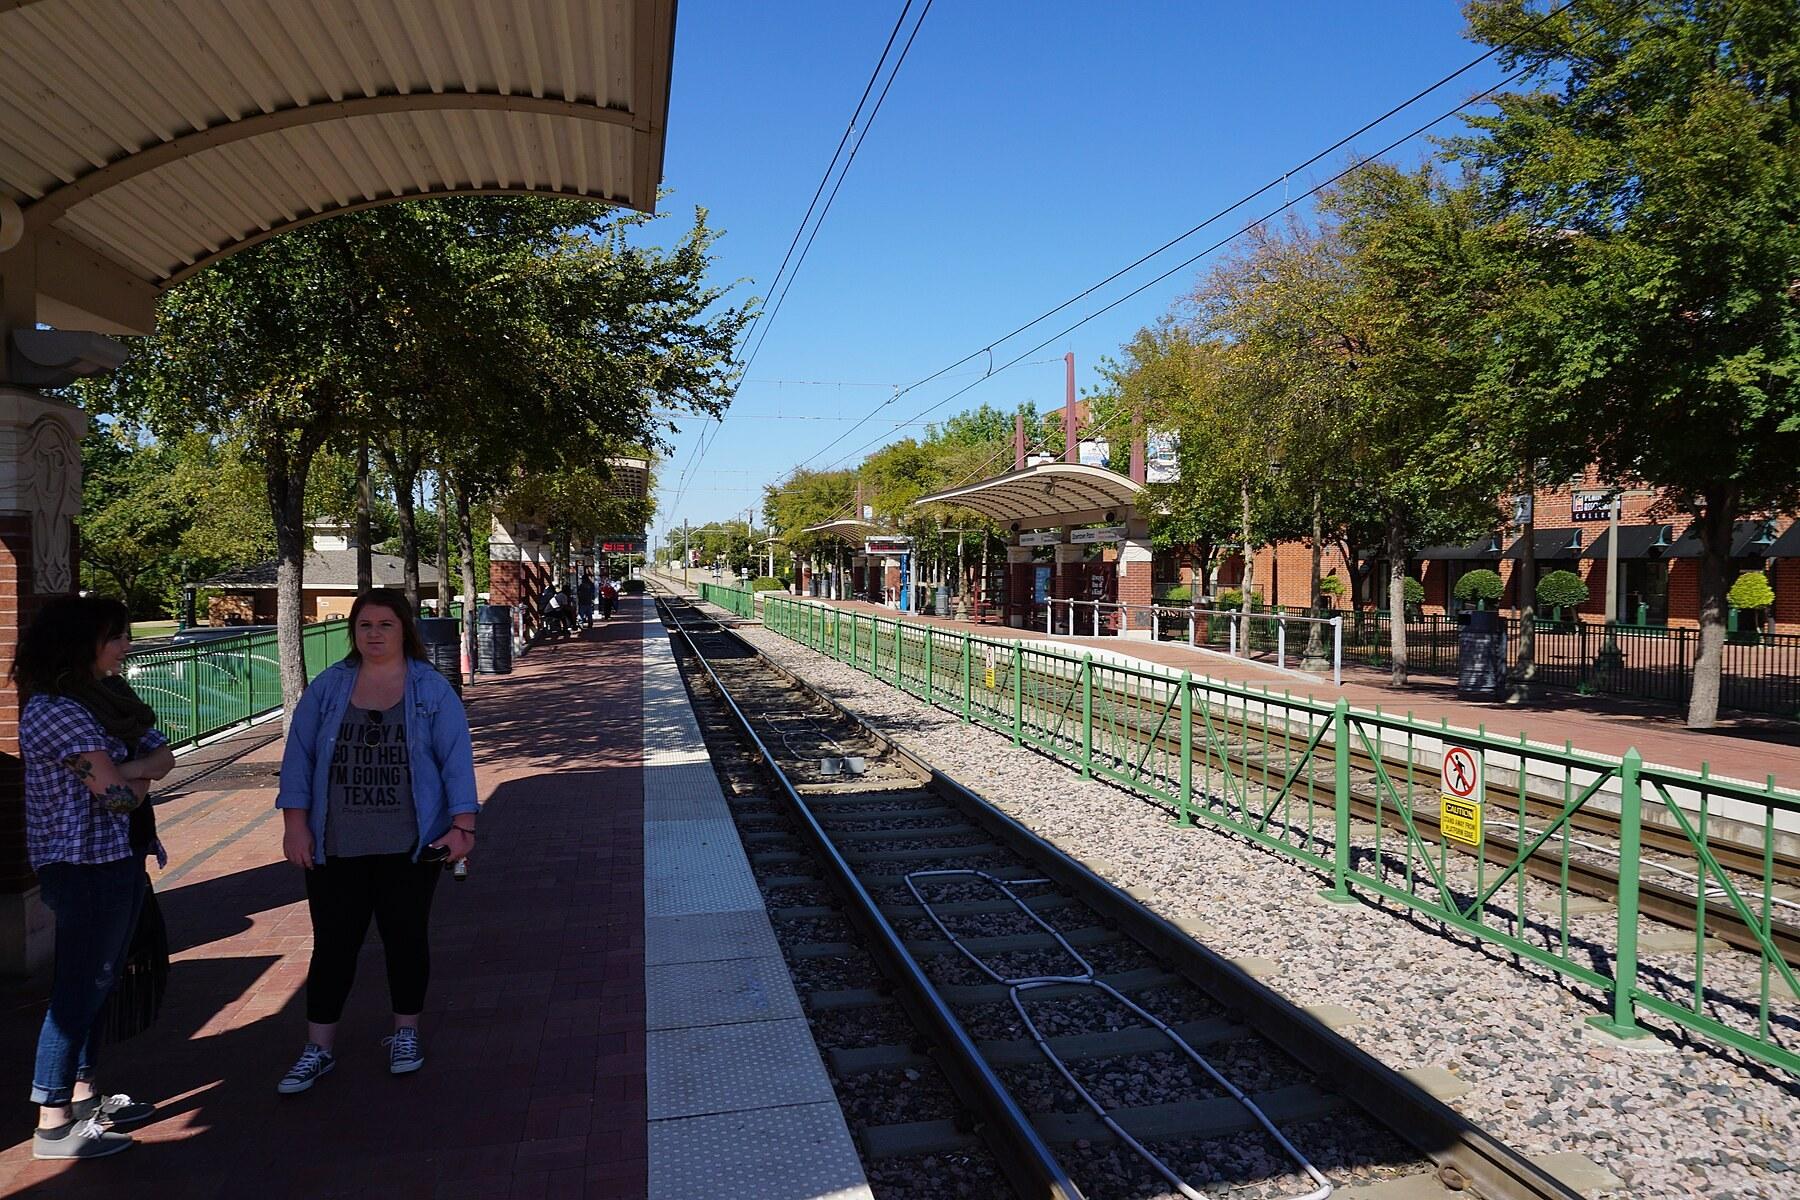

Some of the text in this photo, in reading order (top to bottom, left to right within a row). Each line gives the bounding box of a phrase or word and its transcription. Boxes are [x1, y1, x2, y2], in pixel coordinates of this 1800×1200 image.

[353, 746, 372, 765] TO
[379, 746, 409, 765] HEL
[353, 766, 401, 786] GOING
[404, 767, 412, 785] T
[344, 786, 401, 806] TEXAS.
[1446, 805, 1473, 818] CAUTION
